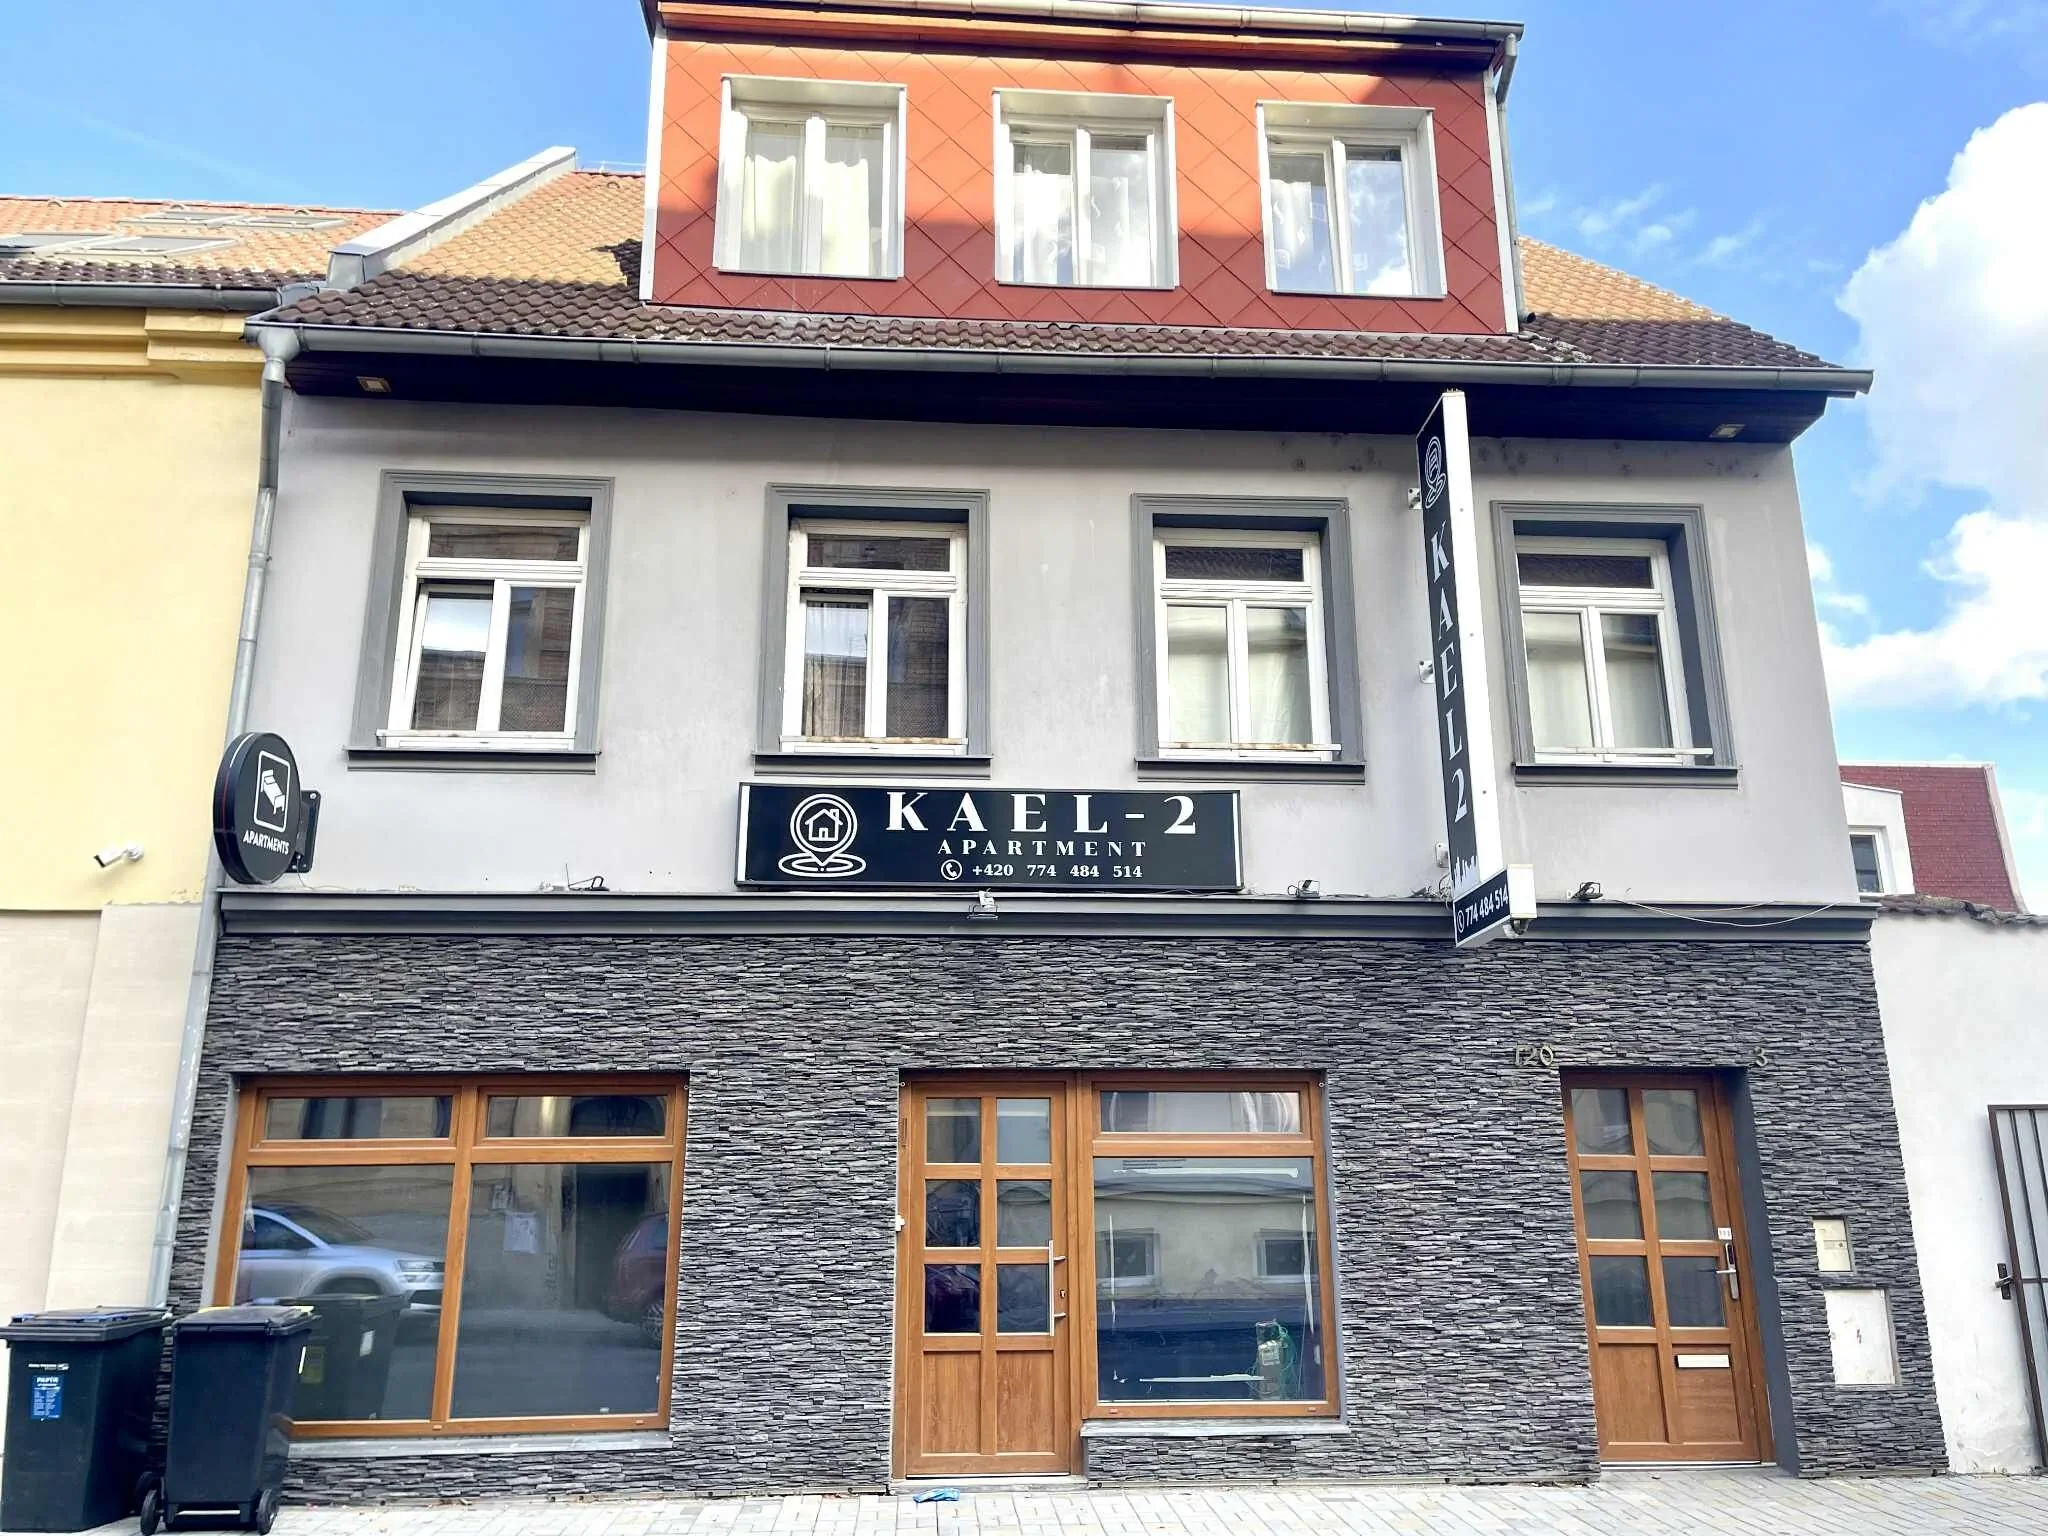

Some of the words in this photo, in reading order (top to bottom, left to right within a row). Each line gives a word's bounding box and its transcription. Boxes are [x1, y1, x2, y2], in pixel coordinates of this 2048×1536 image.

[242, 829, 290, 856] APARTMENTS
[938, 839, 1147, 857] APARTMENT
[972, 864, 1014, 877] +420
[1026, 864, 1057, 877] 774
[1069, 864, 1100, 878] 484
[1112, 865, 1143, 878] 514
[1465, 902, 1479, 928] 774
[1479, 892, 1495, 919] 484
[1494, 883, 1509, 910] 514
